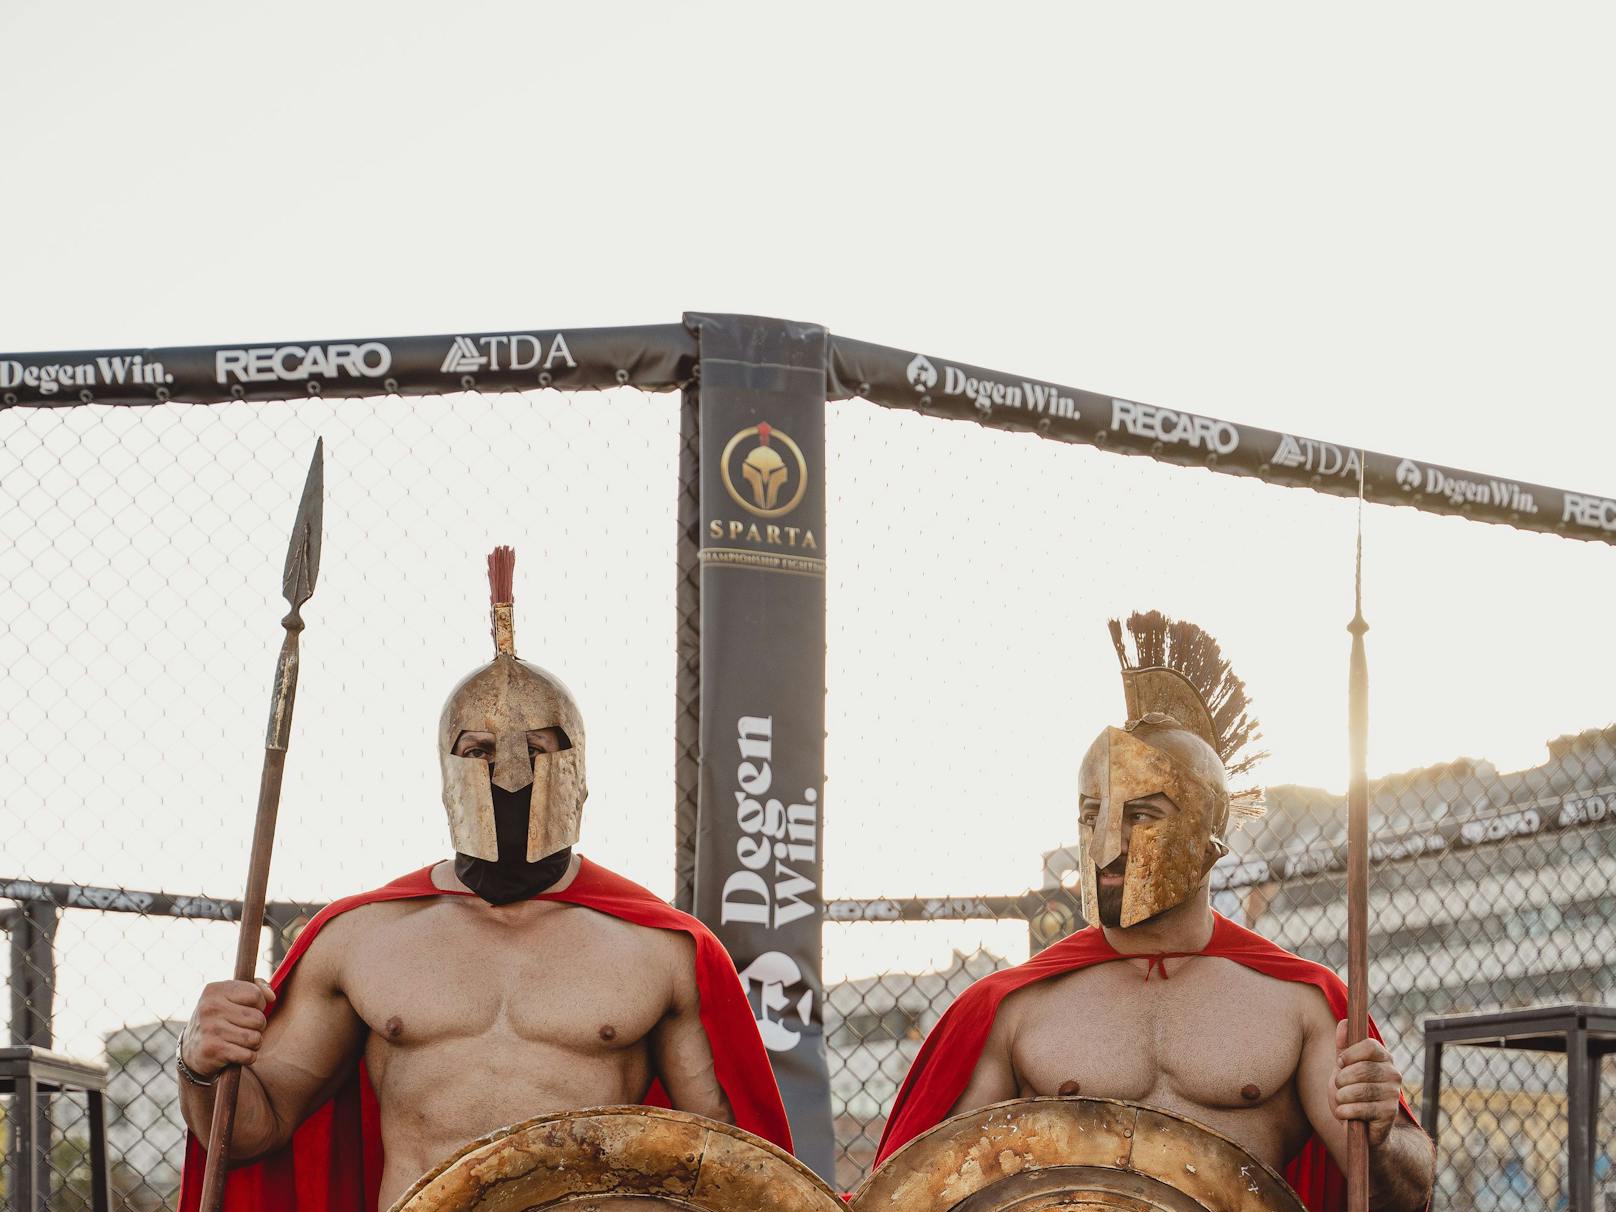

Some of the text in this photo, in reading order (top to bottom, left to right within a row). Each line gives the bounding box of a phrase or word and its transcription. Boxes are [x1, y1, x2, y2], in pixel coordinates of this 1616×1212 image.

[215, 342, 392, 384] RECARO
[480, 333, 577, 371] TDA
[1110, 399, 1240, 455] RECARO
[1299, 438, 1361, 481] TDA
[1562, 493, 1616, 531] REC
[709, 519, 818, 549] SPARTA
[721, 715, 786, 929] Degen
[774, 787, 817, 930] Win.
